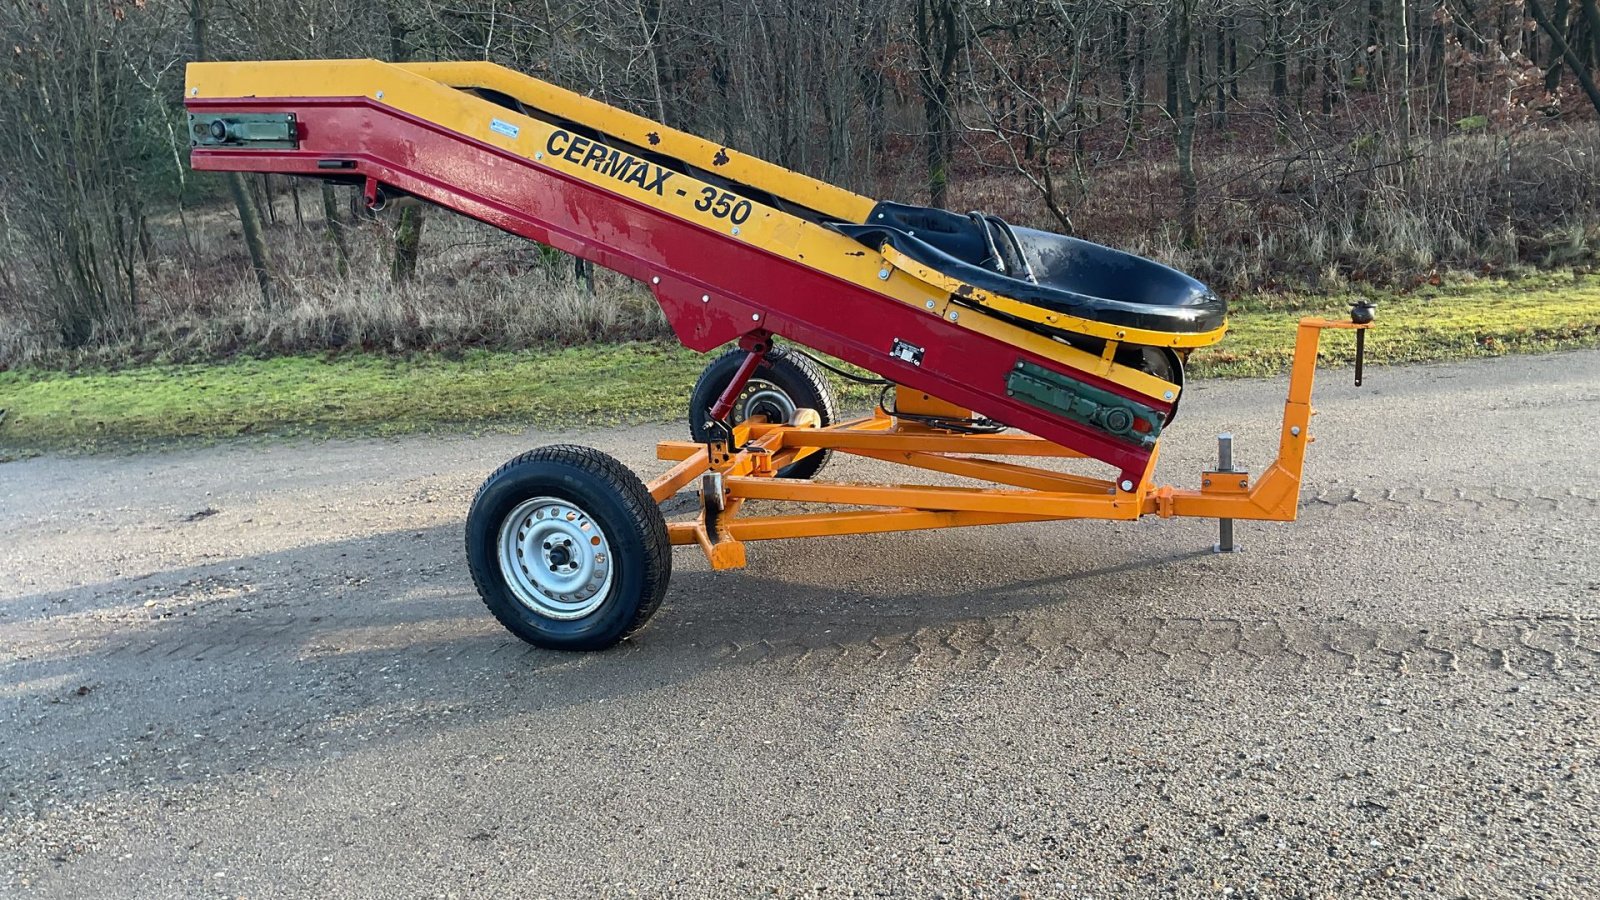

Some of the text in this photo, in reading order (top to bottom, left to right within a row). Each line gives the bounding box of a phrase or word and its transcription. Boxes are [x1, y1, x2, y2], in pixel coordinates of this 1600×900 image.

[546, 130, 753, 226] CERMAX - 350
